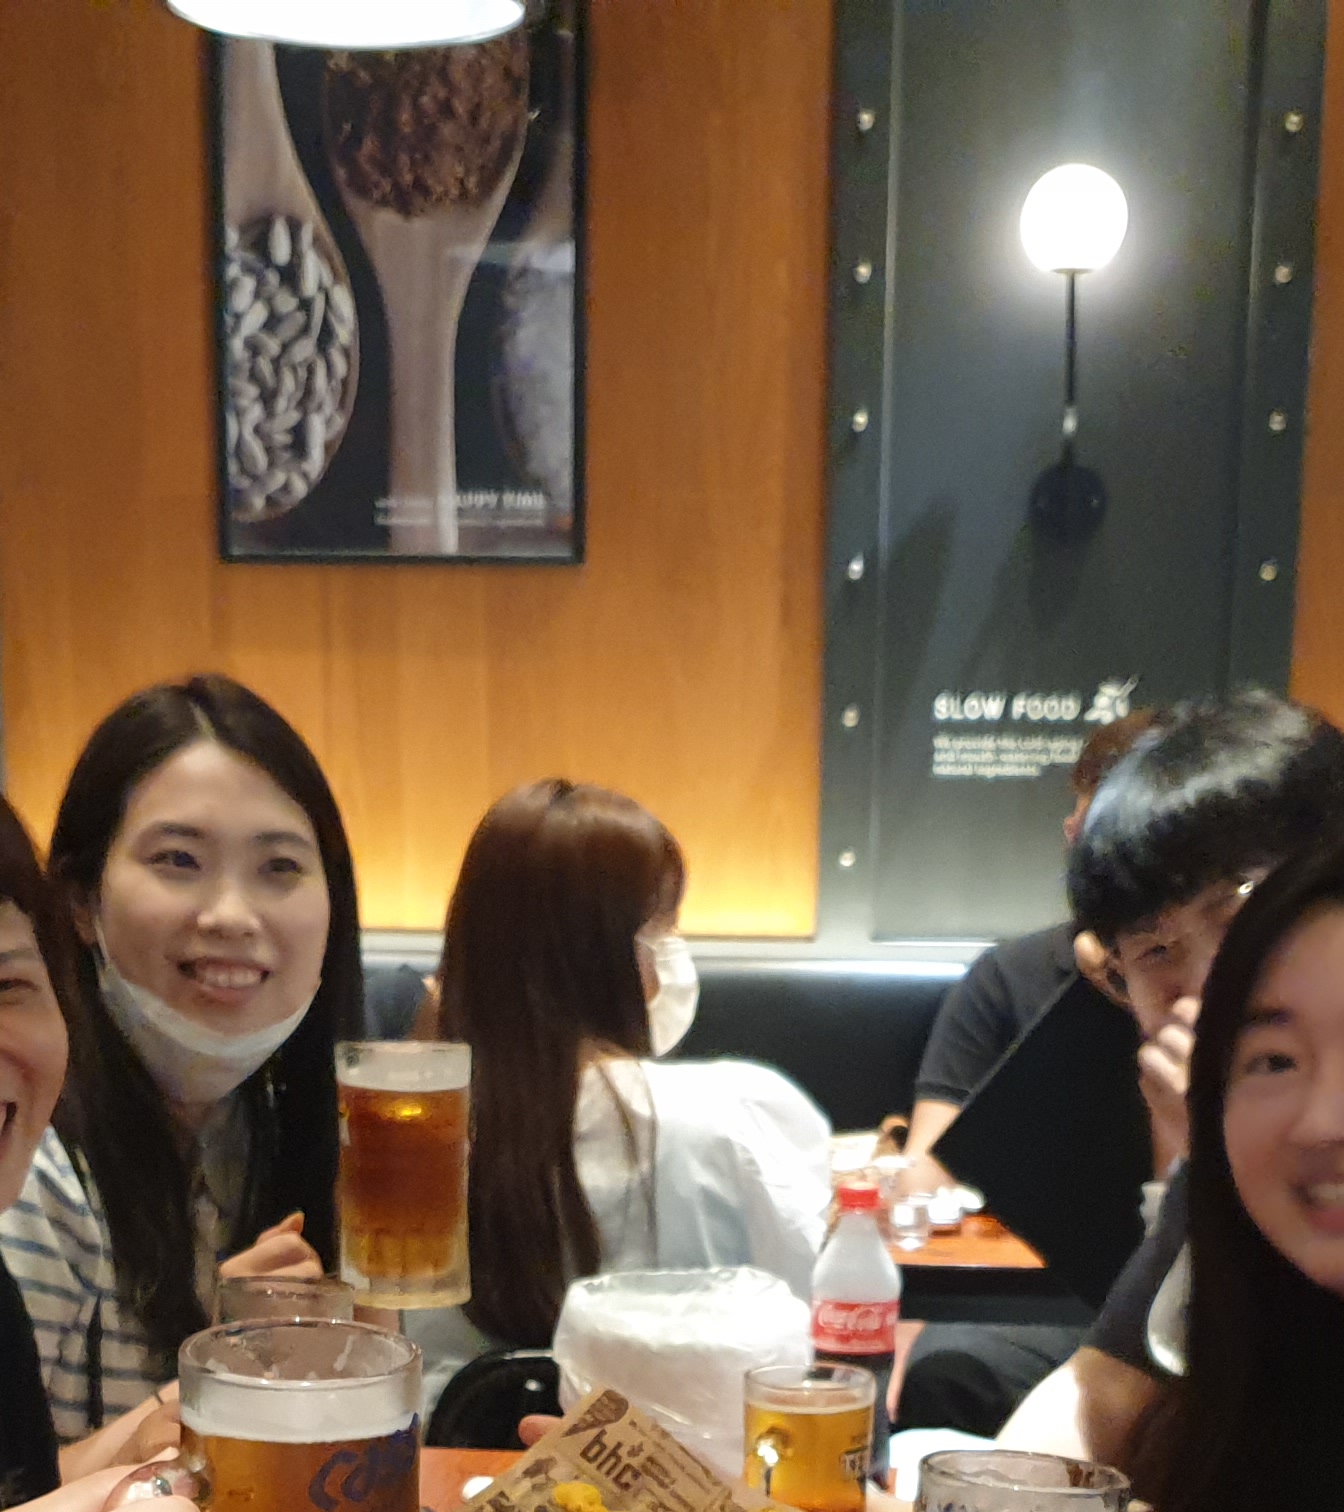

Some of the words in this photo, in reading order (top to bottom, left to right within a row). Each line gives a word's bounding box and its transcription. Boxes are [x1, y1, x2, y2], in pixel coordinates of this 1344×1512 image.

[933, 690, 1006, 721] SLOW
[1012, 691, 1082, 721] FOOD
[579, 1428, 642, 1492] bhc
